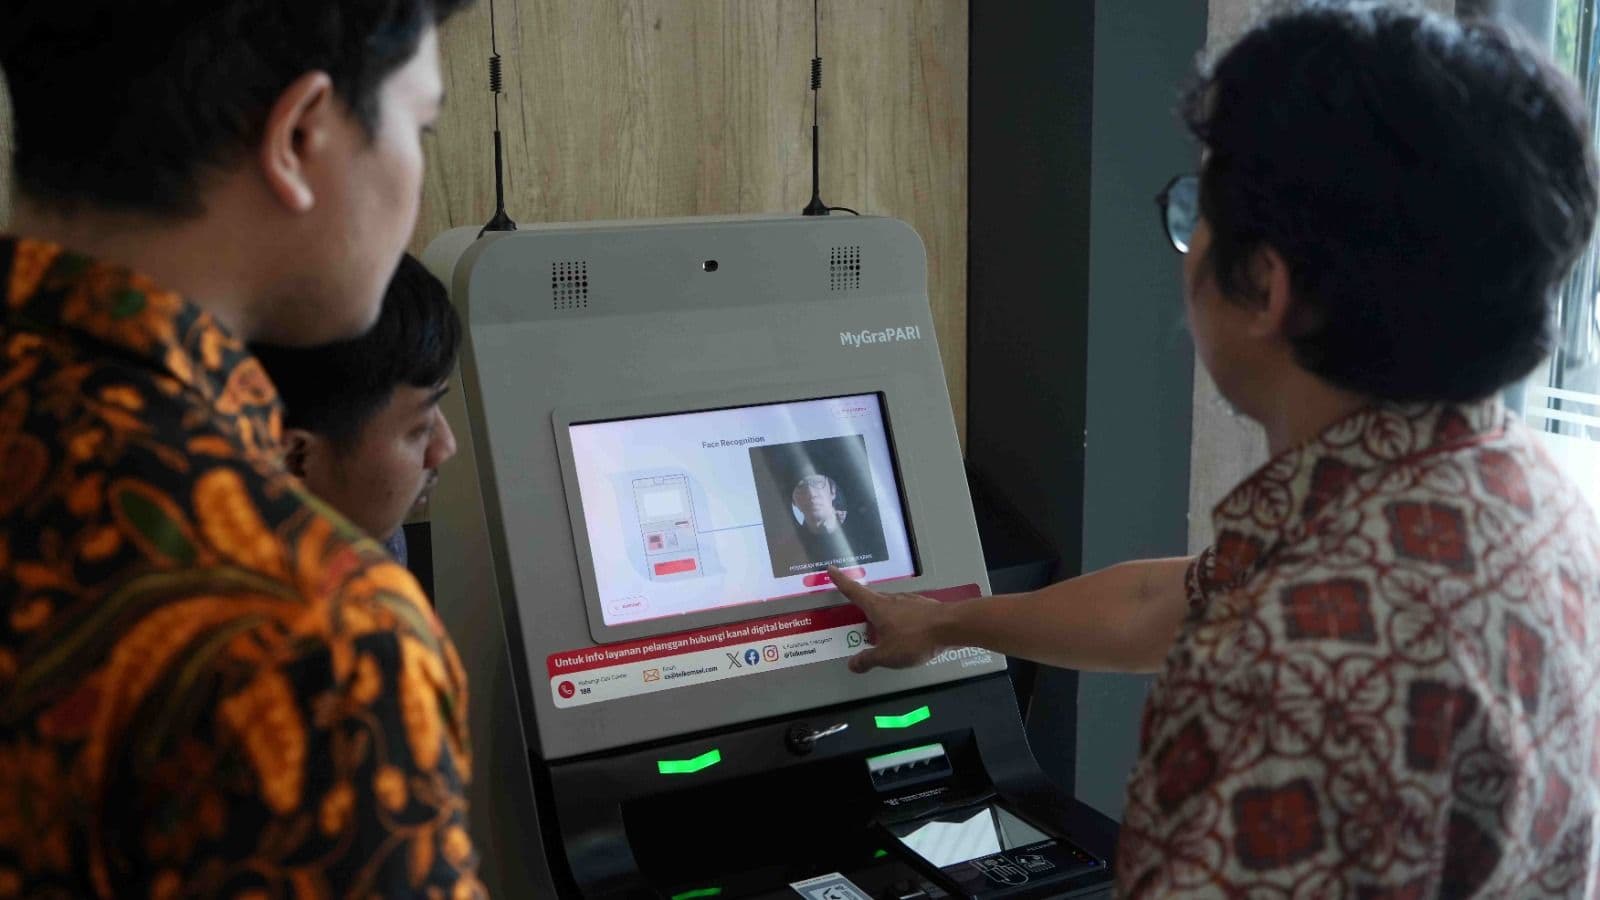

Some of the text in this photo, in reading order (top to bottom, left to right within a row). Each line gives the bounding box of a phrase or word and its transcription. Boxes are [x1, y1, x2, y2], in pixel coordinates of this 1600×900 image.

[840, 325, 920, 347] MyGraPARI
[702, 436, 765, 449] Face Recognition
[555, 617, 812, 668] Untuk info layanan pelanggan hubungi kanal digital berikut:
